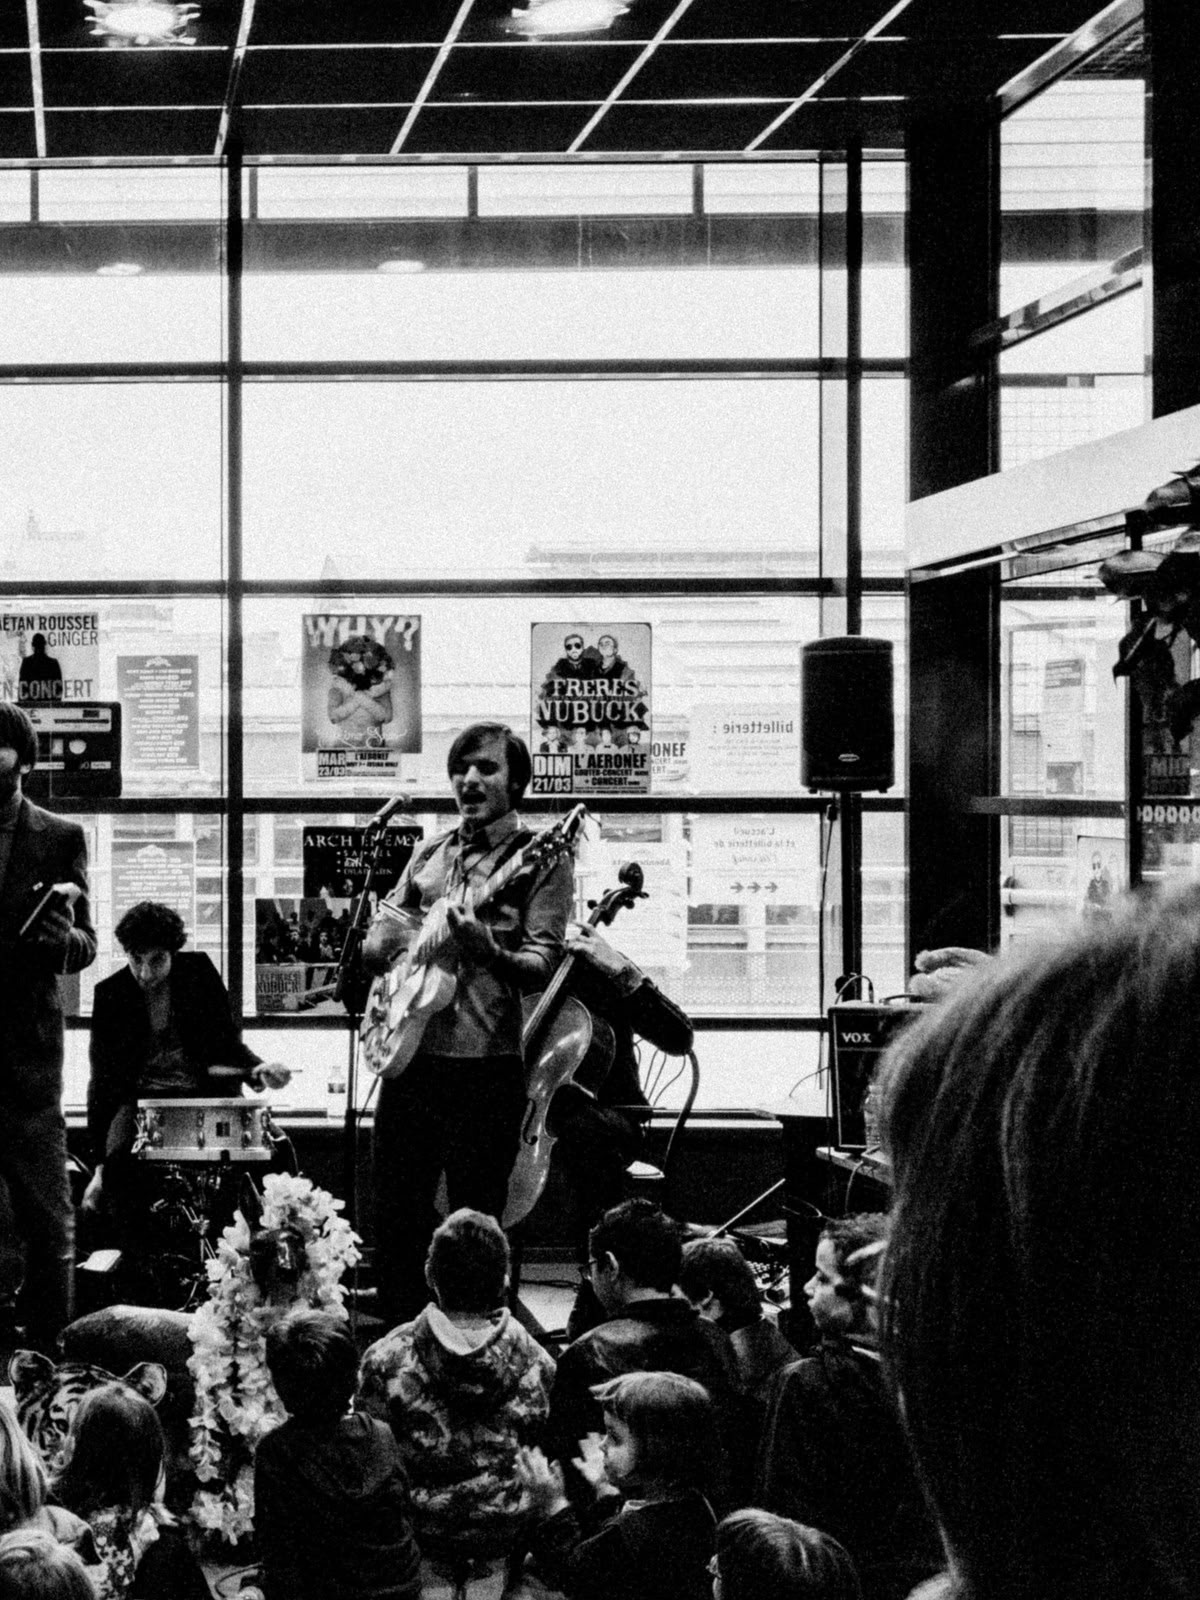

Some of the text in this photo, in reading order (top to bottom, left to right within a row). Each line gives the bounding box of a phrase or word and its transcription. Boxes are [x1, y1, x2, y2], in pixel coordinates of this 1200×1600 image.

[39, 615, 98, 630] ROUSSEL
[47, 631, 98, 647] GINGER
[305, 615, 420, 651] WHY?
[18, 679, 93, 700] CONCERT
[552, 678, 639, 697] FRERES
[536, 700, 641, 723] NUBUCK
[320, 752, 345, 766] MAR
[534, 755, 571, 776] DIM
[319, 766, 345, 776] 23/03
[534, 778, 571, 792] 21/03
[591, 777, 628, 786] CONCERT
[304, 834, 353, 848] ARCH
[841, 1032, 872, 1043] VOX
